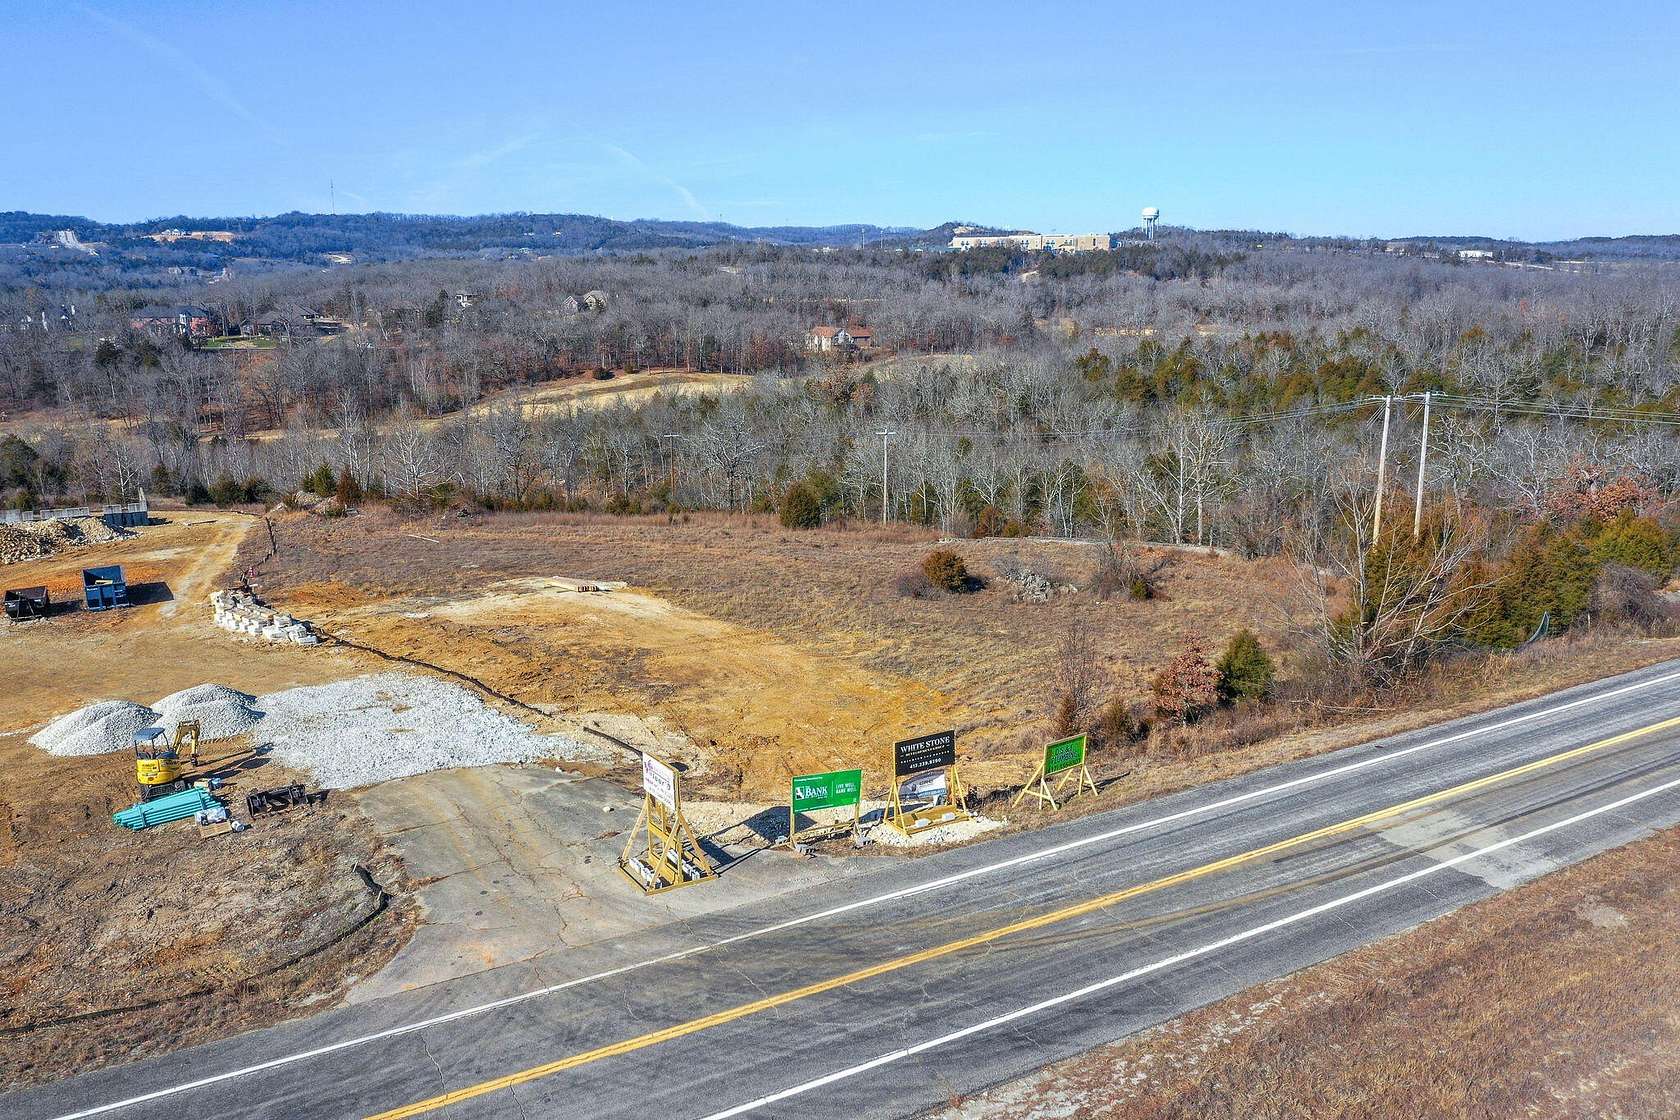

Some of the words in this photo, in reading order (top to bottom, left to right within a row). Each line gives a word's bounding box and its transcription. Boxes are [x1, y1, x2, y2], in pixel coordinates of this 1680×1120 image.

[900, 741, 925, 753] WHITE
[925, 735, 950, 747] STONE
[804, 786, 828, 798] BANK
